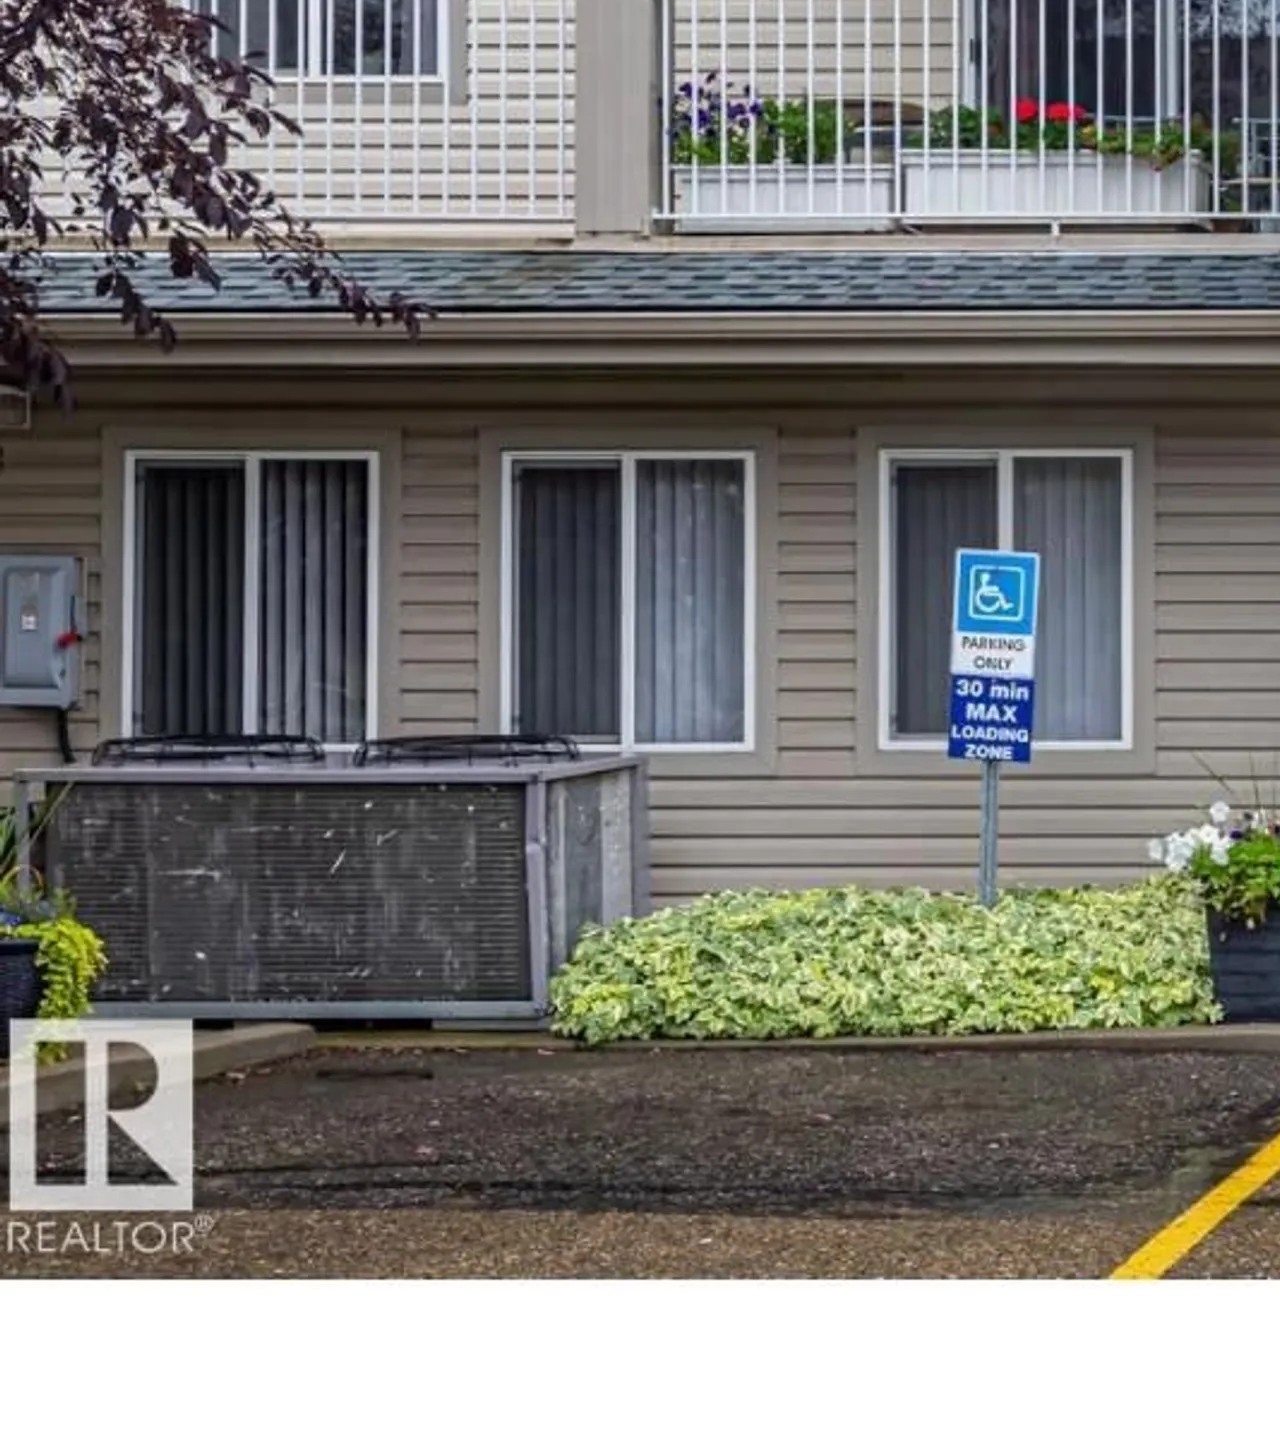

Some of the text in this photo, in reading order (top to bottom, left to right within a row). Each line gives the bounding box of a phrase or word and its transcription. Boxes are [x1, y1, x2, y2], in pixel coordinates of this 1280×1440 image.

[961, 635, 1026, 652] PARKING
[973, 655, 1015, 671] ONLY
[956, 679, 1030, 701] 30 min
[965, 703, 1017, 723] MAX
[951, 725, 1029, 743] LOADING
[964, 744, 1014, 760] ZONE
